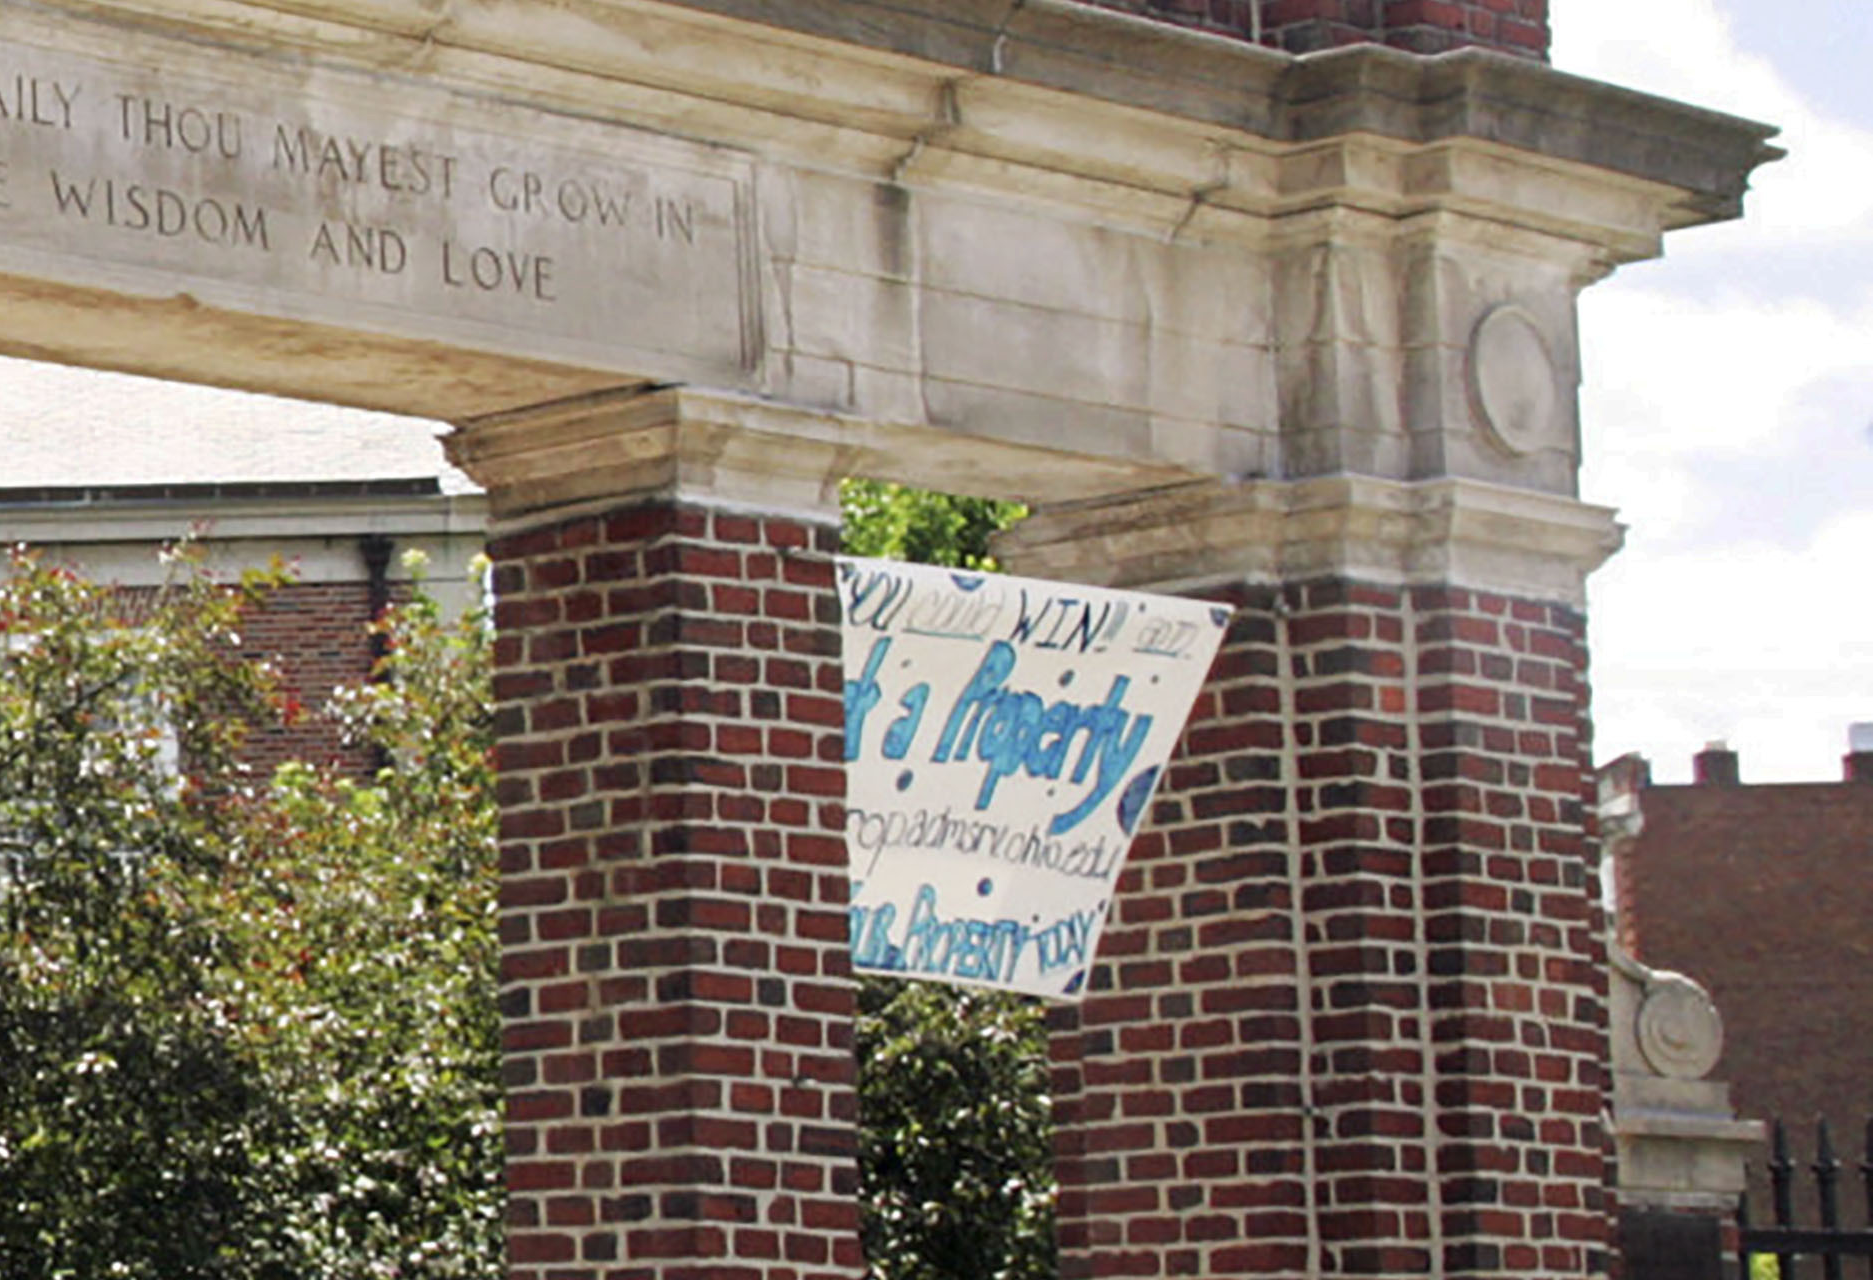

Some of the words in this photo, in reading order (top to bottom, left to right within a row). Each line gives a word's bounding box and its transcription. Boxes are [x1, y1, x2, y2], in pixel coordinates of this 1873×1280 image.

[51, 167, 271, 251] WISDOM
[310, 221, 408, 276] AND
[442, 239, 558, 302] LOVE
[114, 91, 244, 160] THOU
[272, 124, 460, 201] MAYEST
[488, 166, 634, 227] GROW
[655, 196, 696, 245] IN
[881, 682, 931, 761] a
[930, 638, 1154, 835] Property
